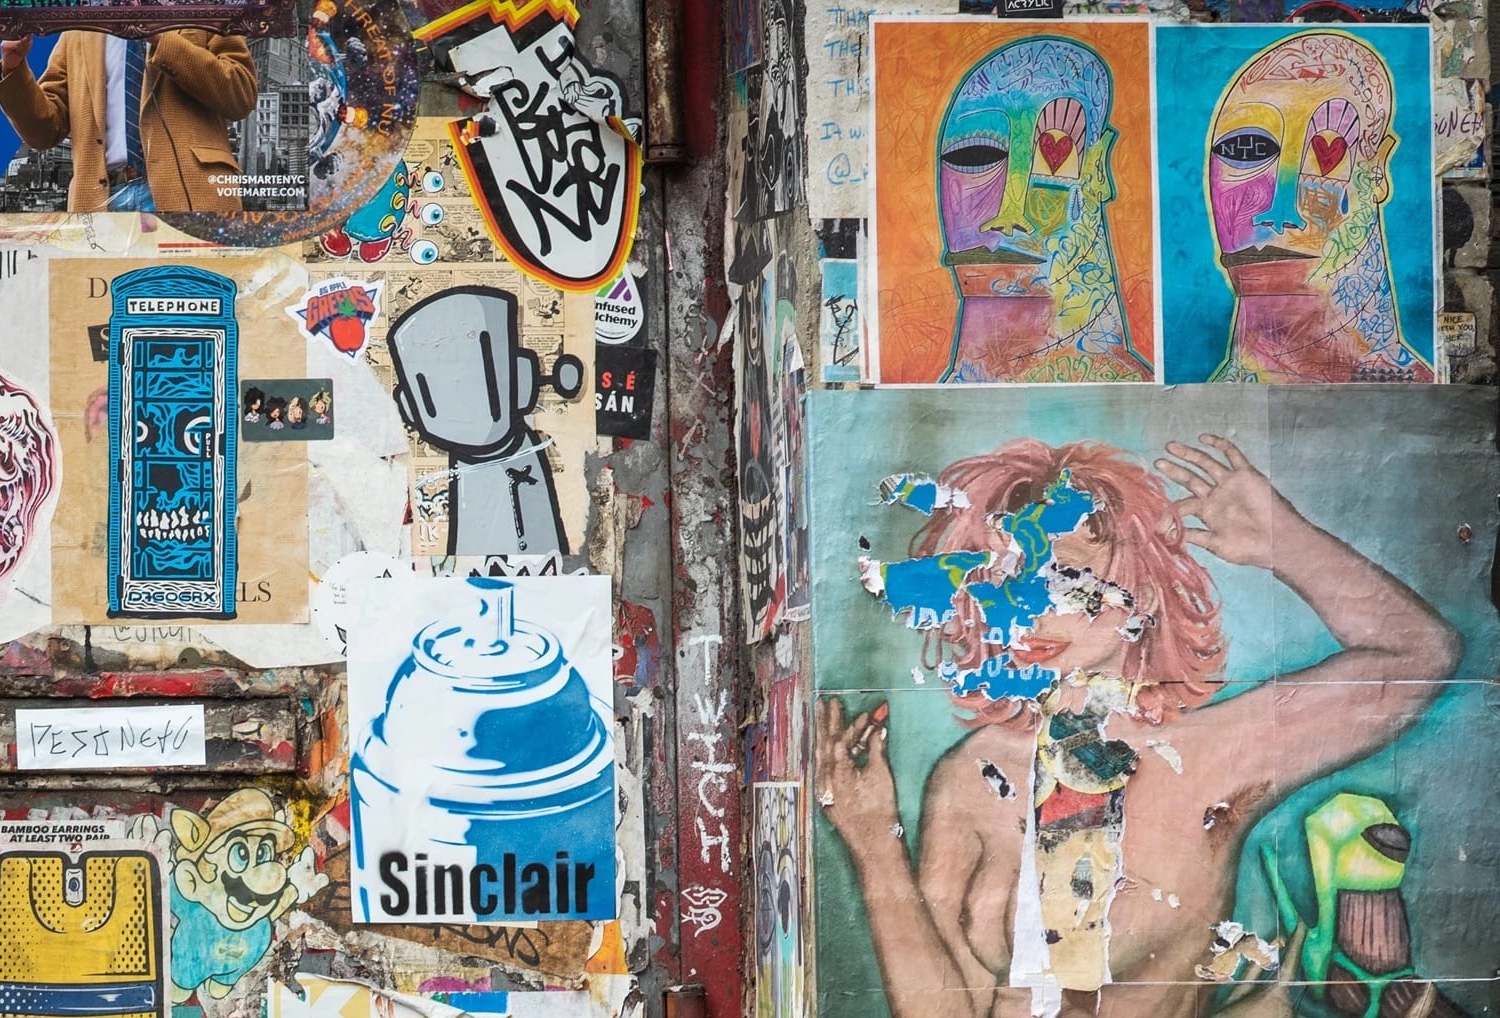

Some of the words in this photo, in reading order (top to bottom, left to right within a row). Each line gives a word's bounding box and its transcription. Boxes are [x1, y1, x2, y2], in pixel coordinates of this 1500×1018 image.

[1220, 132, 1267, 158] NYC
[208, 174, 305, 186] @CHRISMARTENYC
[217, 187, 306, 198] VOTEMARTE.COM
[129, 301, 219, 312] TELEPHONE
[1, 825, 50, 834] BAMBOO
[52, 825, 105, 834] EARRINGS
[10, 835, 25, 843] AT
[25, 835, 57, 843] LEAST
[58, 835, 83, 843] TWO
[379, 850, 596, 917] Sinclair
